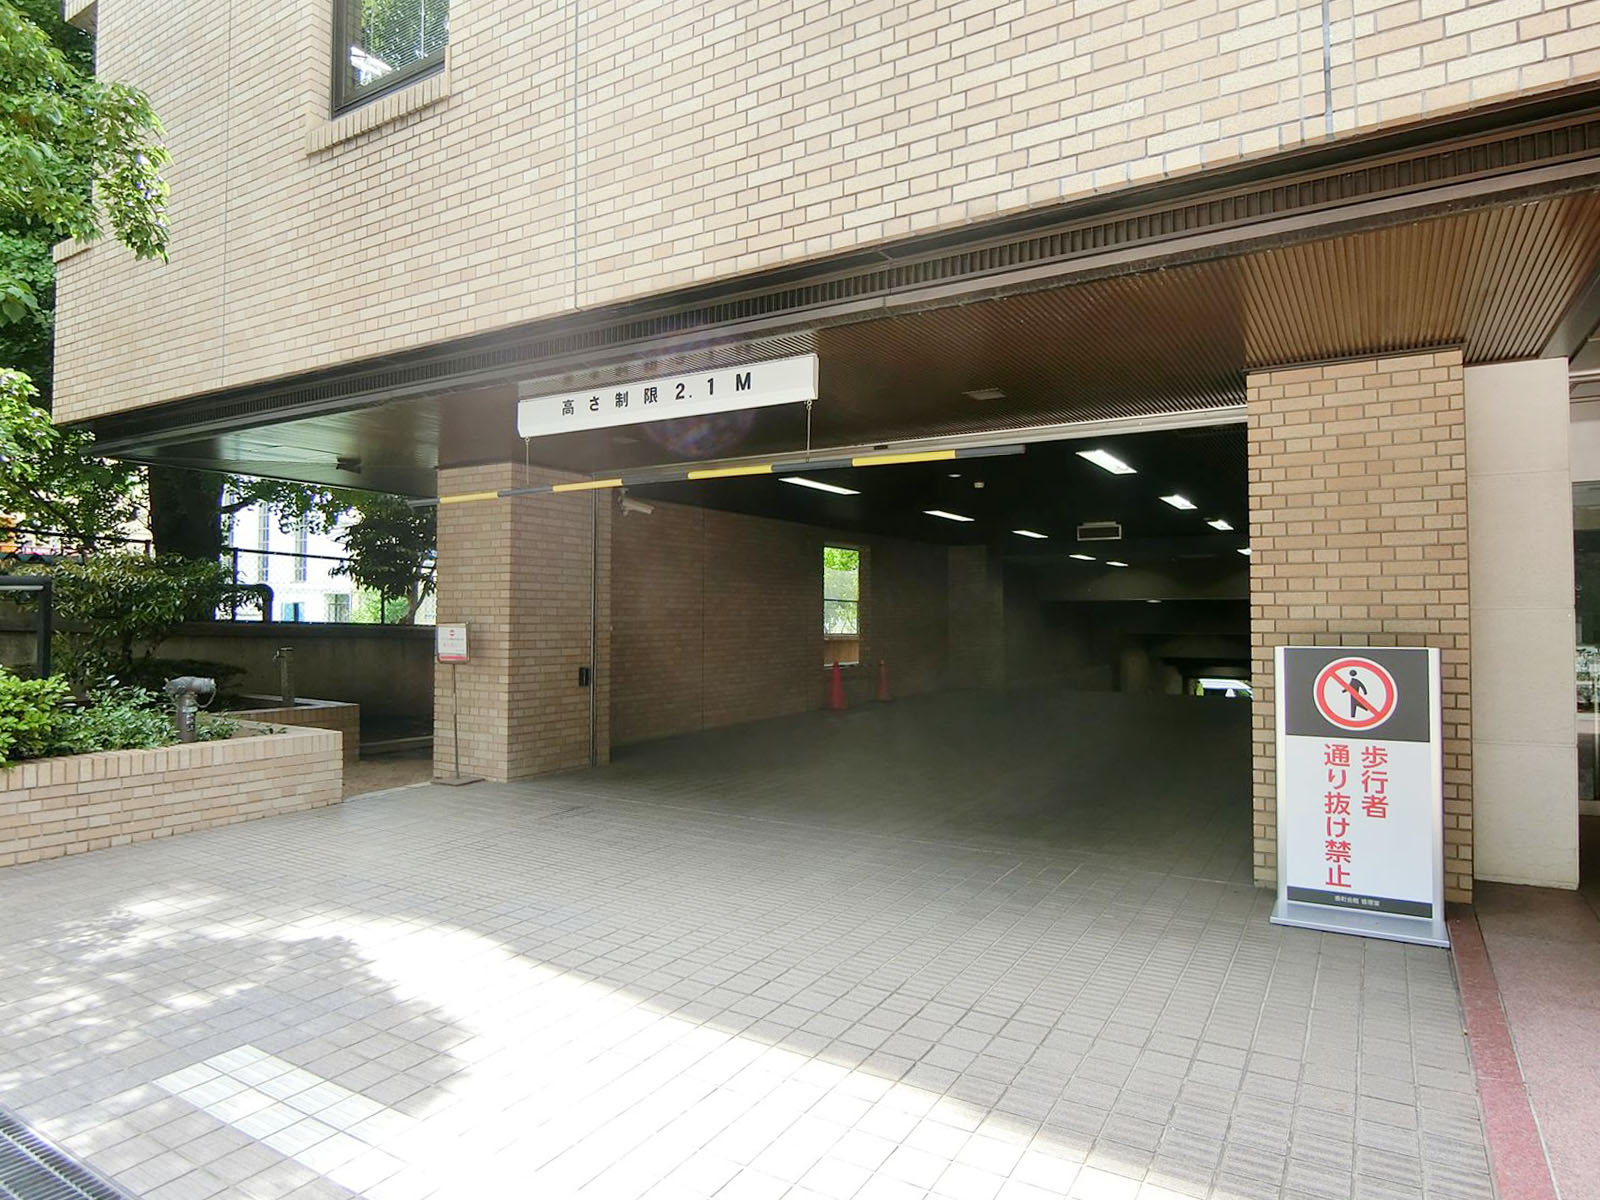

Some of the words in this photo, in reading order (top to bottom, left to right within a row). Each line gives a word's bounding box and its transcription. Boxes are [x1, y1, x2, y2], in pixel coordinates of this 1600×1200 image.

[1324, 743, 1352, 888] 通り抜け禁止
[1361, 746, 1389, 819] 歩行者
